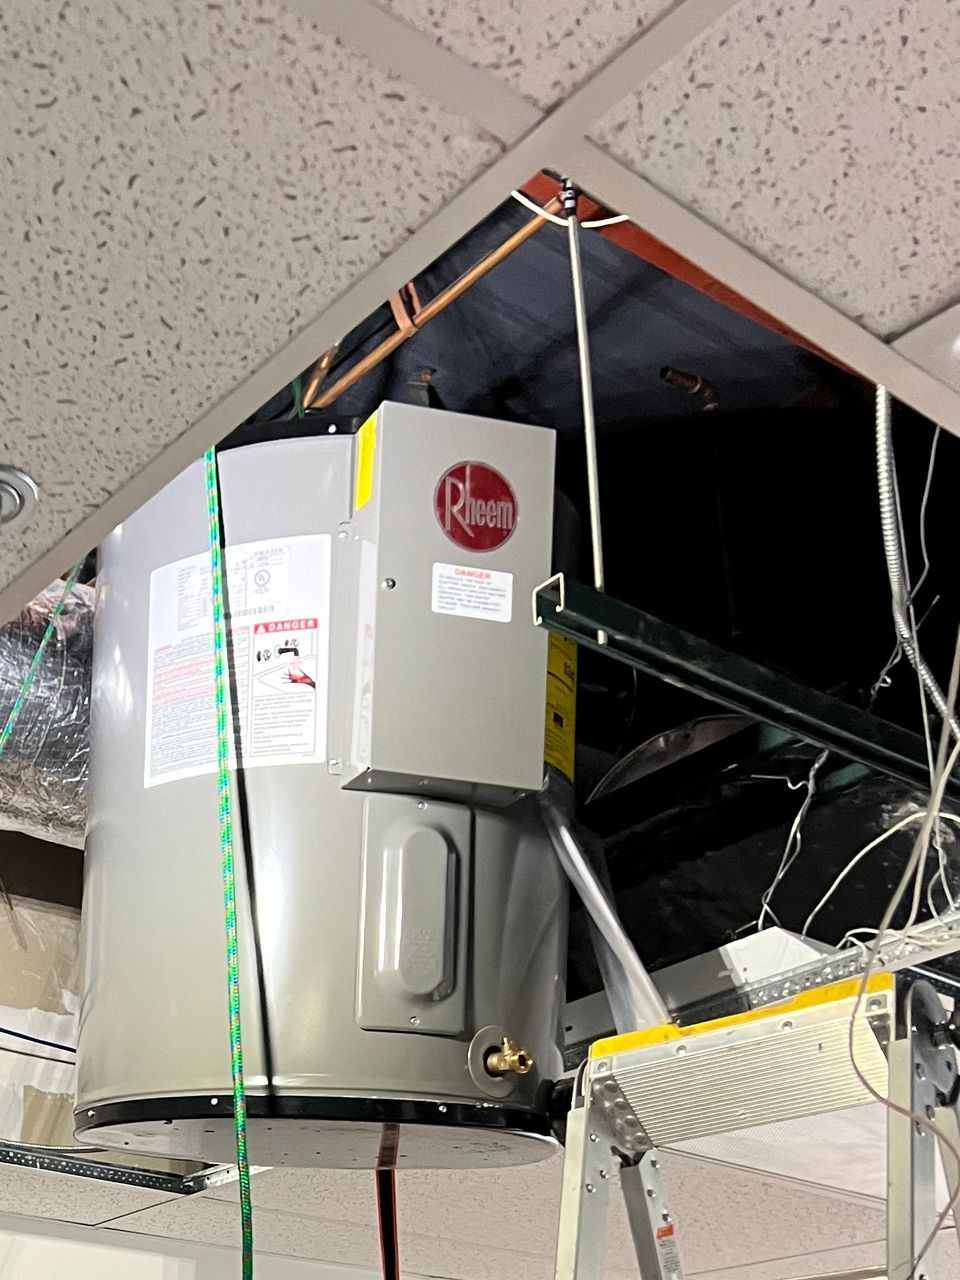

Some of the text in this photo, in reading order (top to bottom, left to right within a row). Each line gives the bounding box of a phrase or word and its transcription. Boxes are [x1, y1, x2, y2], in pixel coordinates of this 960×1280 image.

[444, 464, 513, 538] Rheem
[454, 568, 492, 581] DANGER
[268, 619, 316, 632] DANGER
